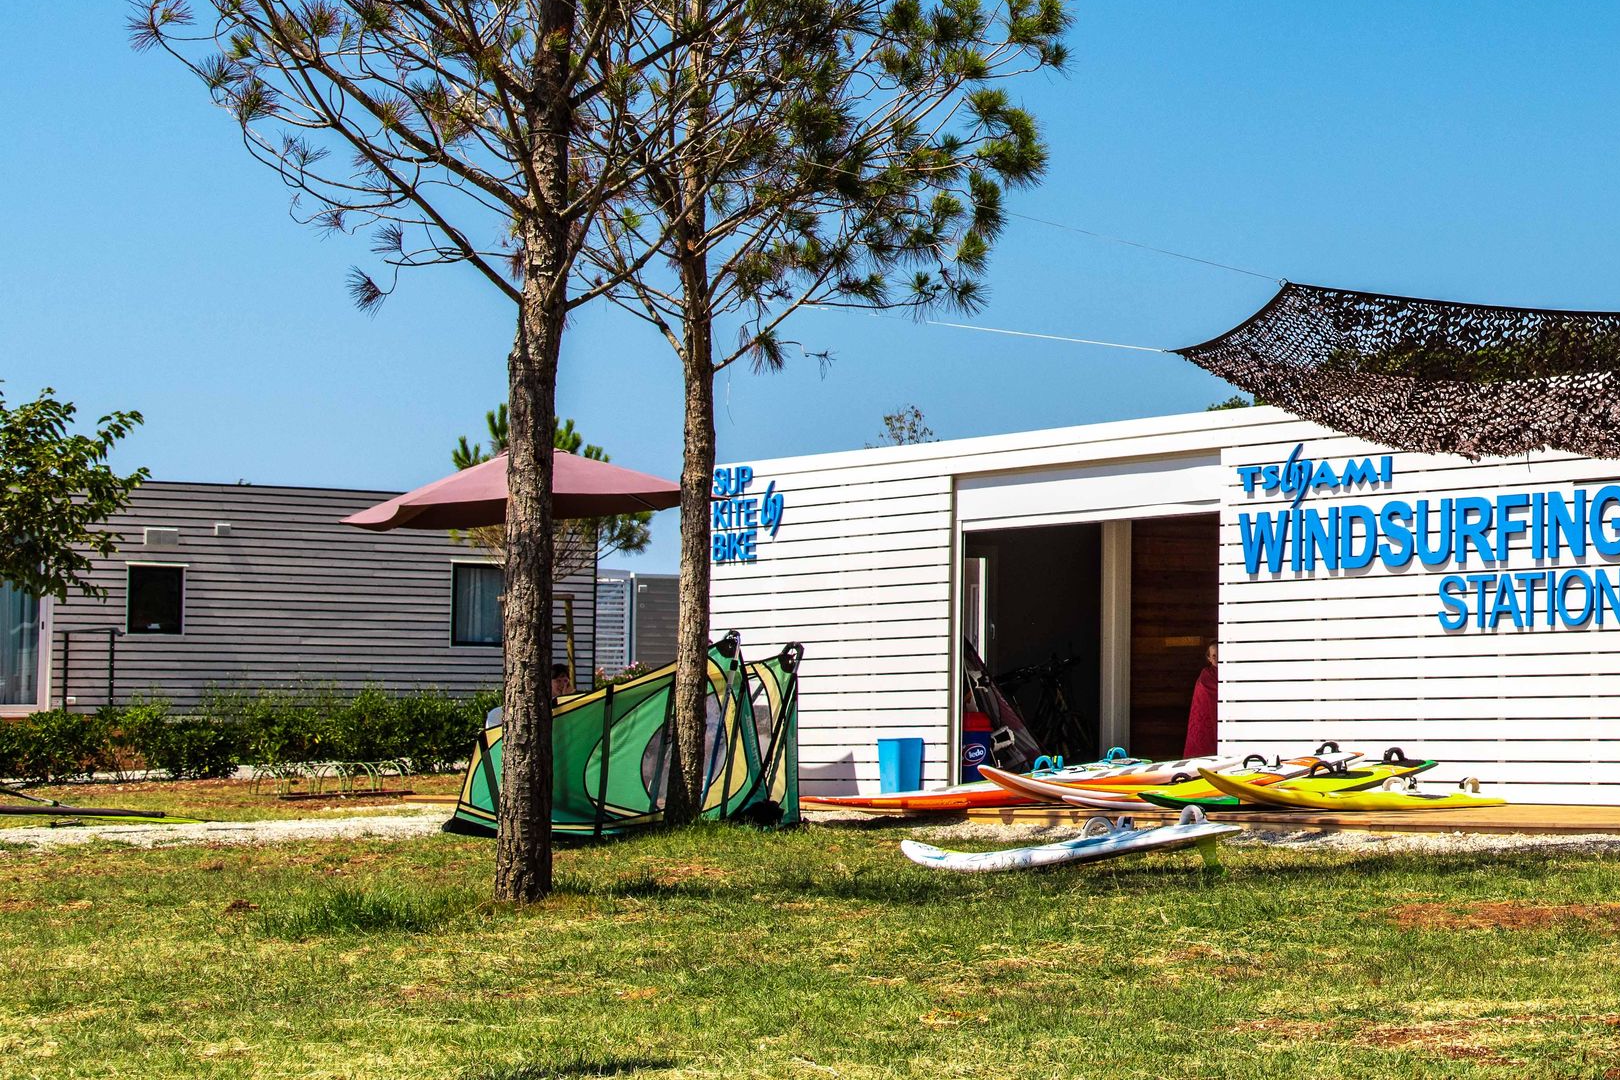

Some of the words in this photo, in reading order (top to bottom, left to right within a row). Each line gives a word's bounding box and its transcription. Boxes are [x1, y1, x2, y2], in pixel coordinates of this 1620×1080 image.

[713, 466, 753, 496] SUP
[713, 498, 757, 528] KITE
[713, 531, 757, 561] BIKE
